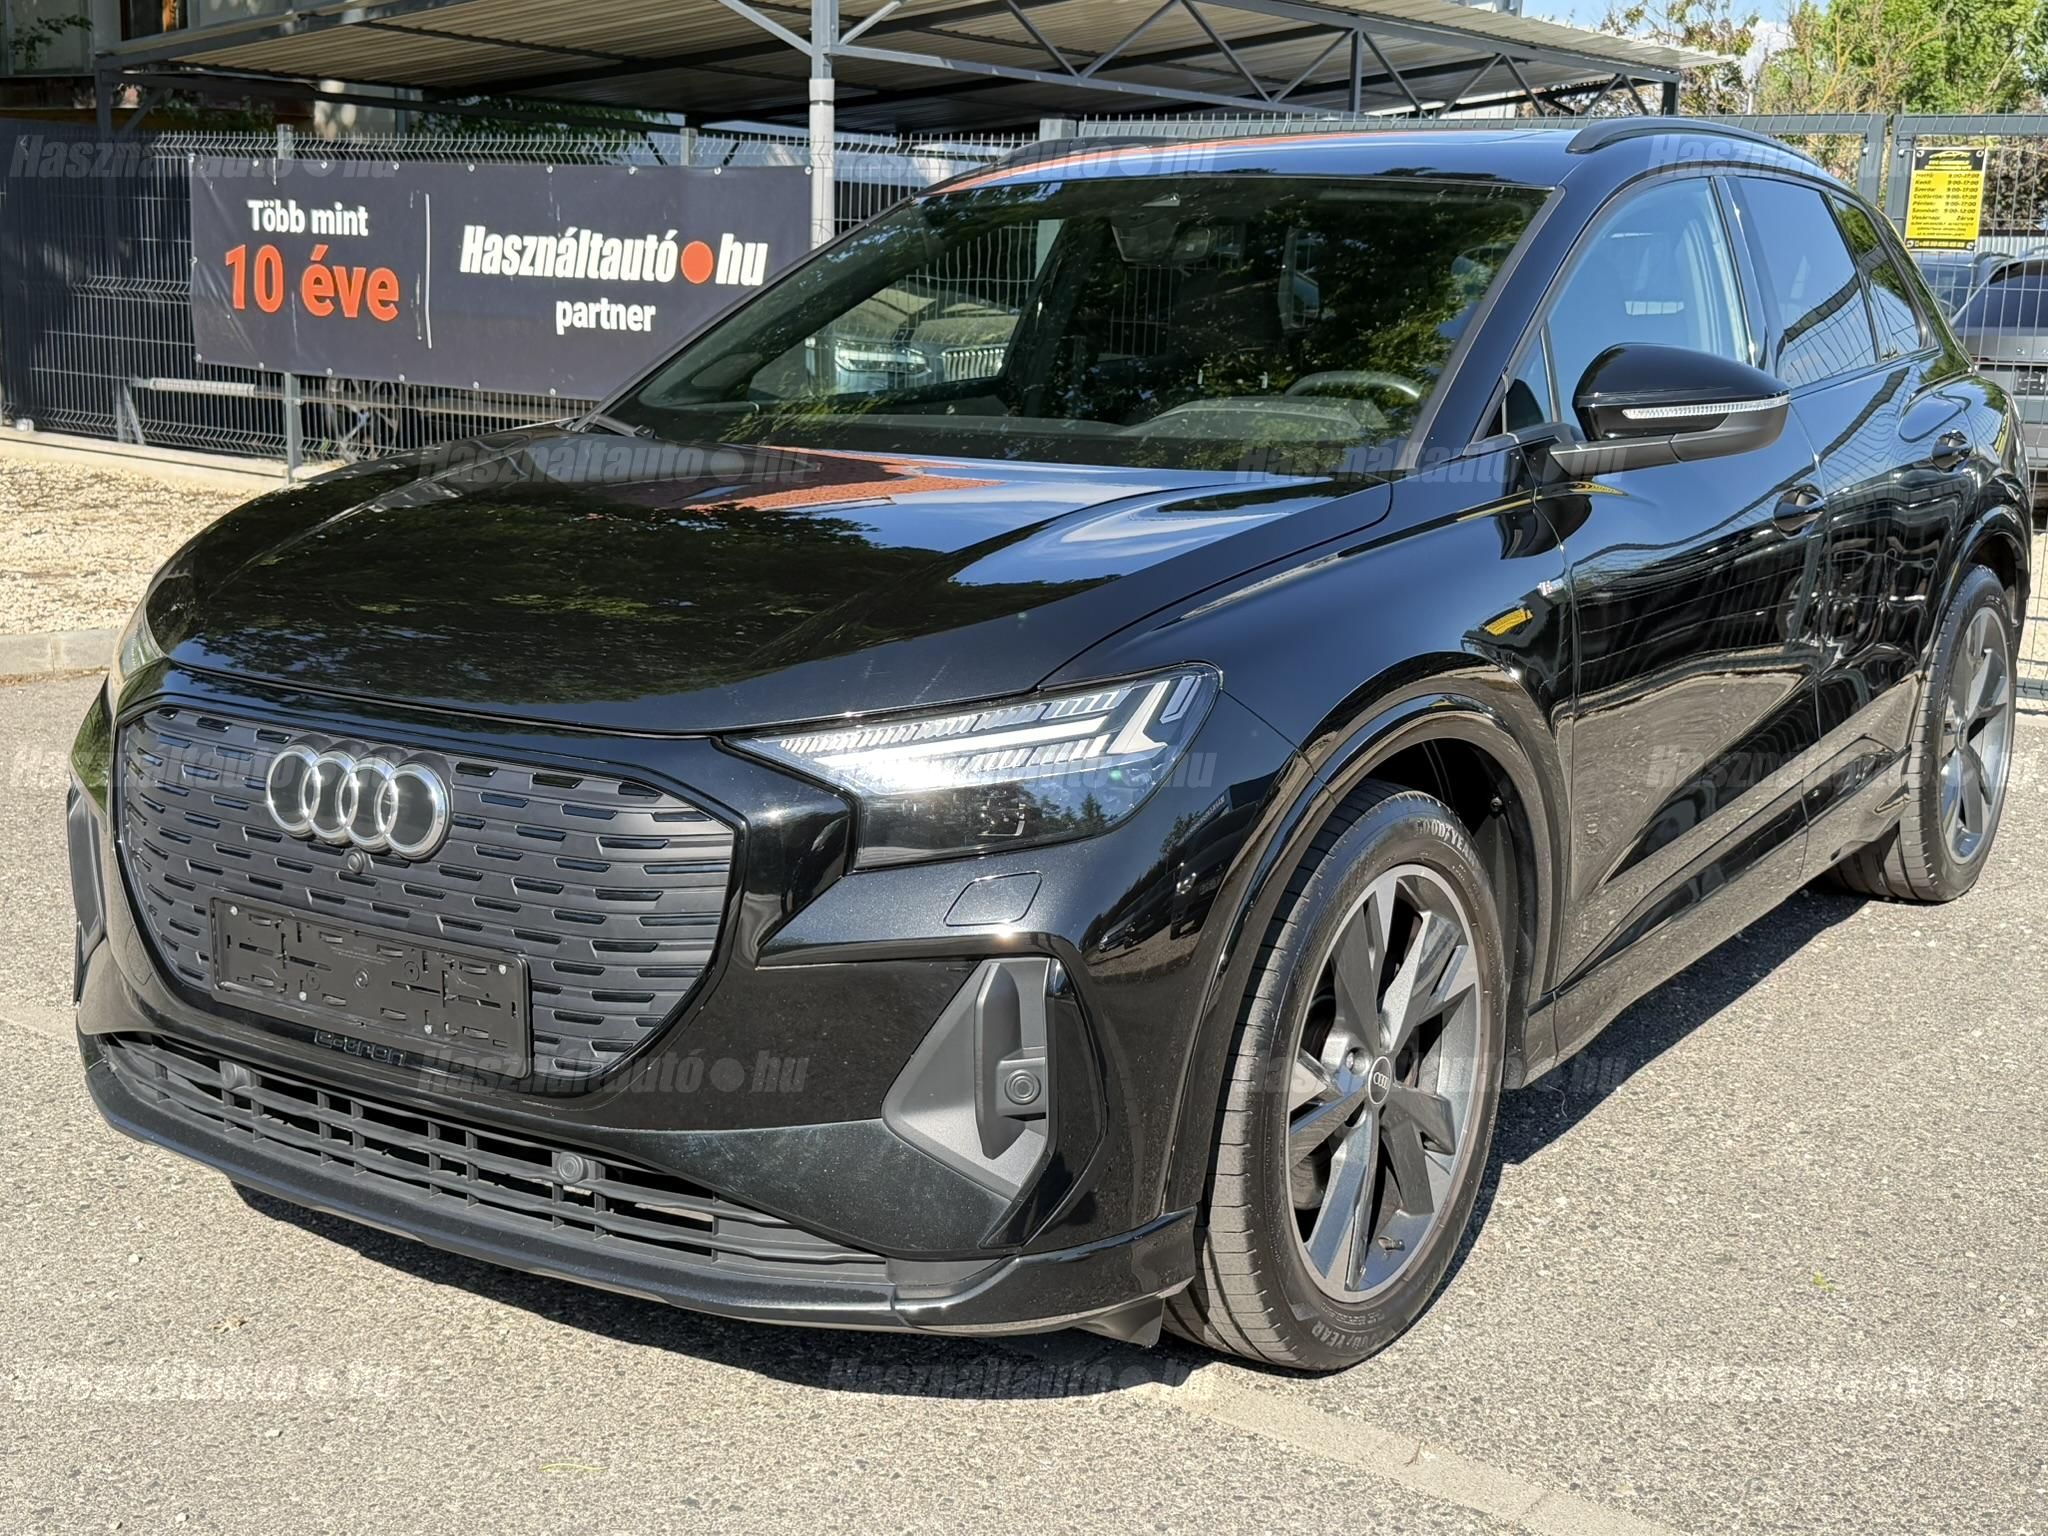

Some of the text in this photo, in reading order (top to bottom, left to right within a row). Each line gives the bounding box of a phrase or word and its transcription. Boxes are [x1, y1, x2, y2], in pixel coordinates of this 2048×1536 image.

[247, 199, 369, 237] Több mint
[225, 244, 400, 322] 10 éve
[555, 297, 657, 336] partner
